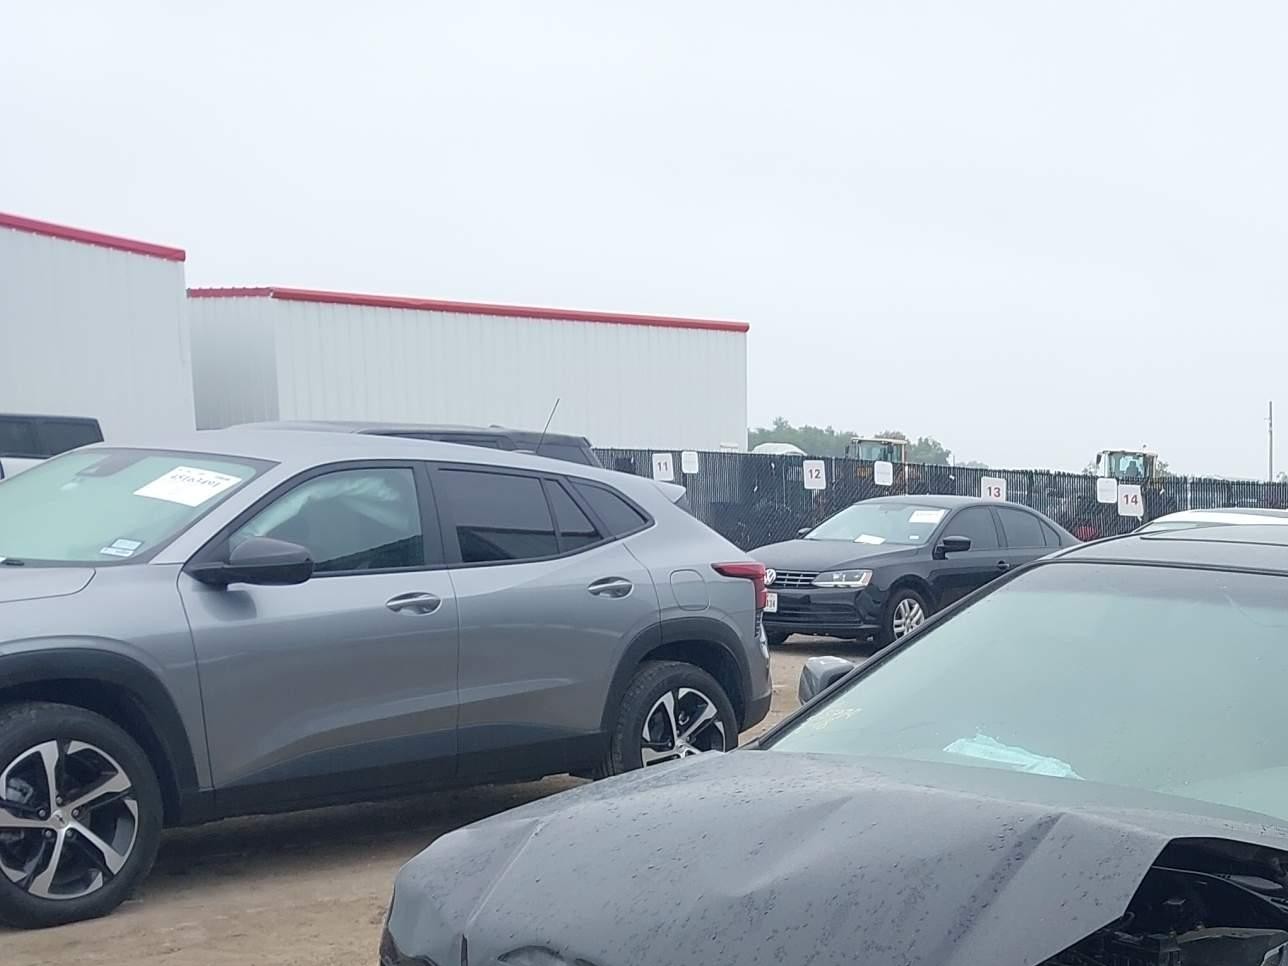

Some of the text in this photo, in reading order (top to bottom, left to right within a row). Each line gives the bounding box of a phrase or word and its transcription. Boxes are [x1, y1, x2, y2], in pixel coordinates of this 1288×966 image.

[656, 461, 669, 473] 11
[808, 468, 822, 480] 12
[986, 486, 1001, 498] 13
[1123, 494, 1138, 505] 14
